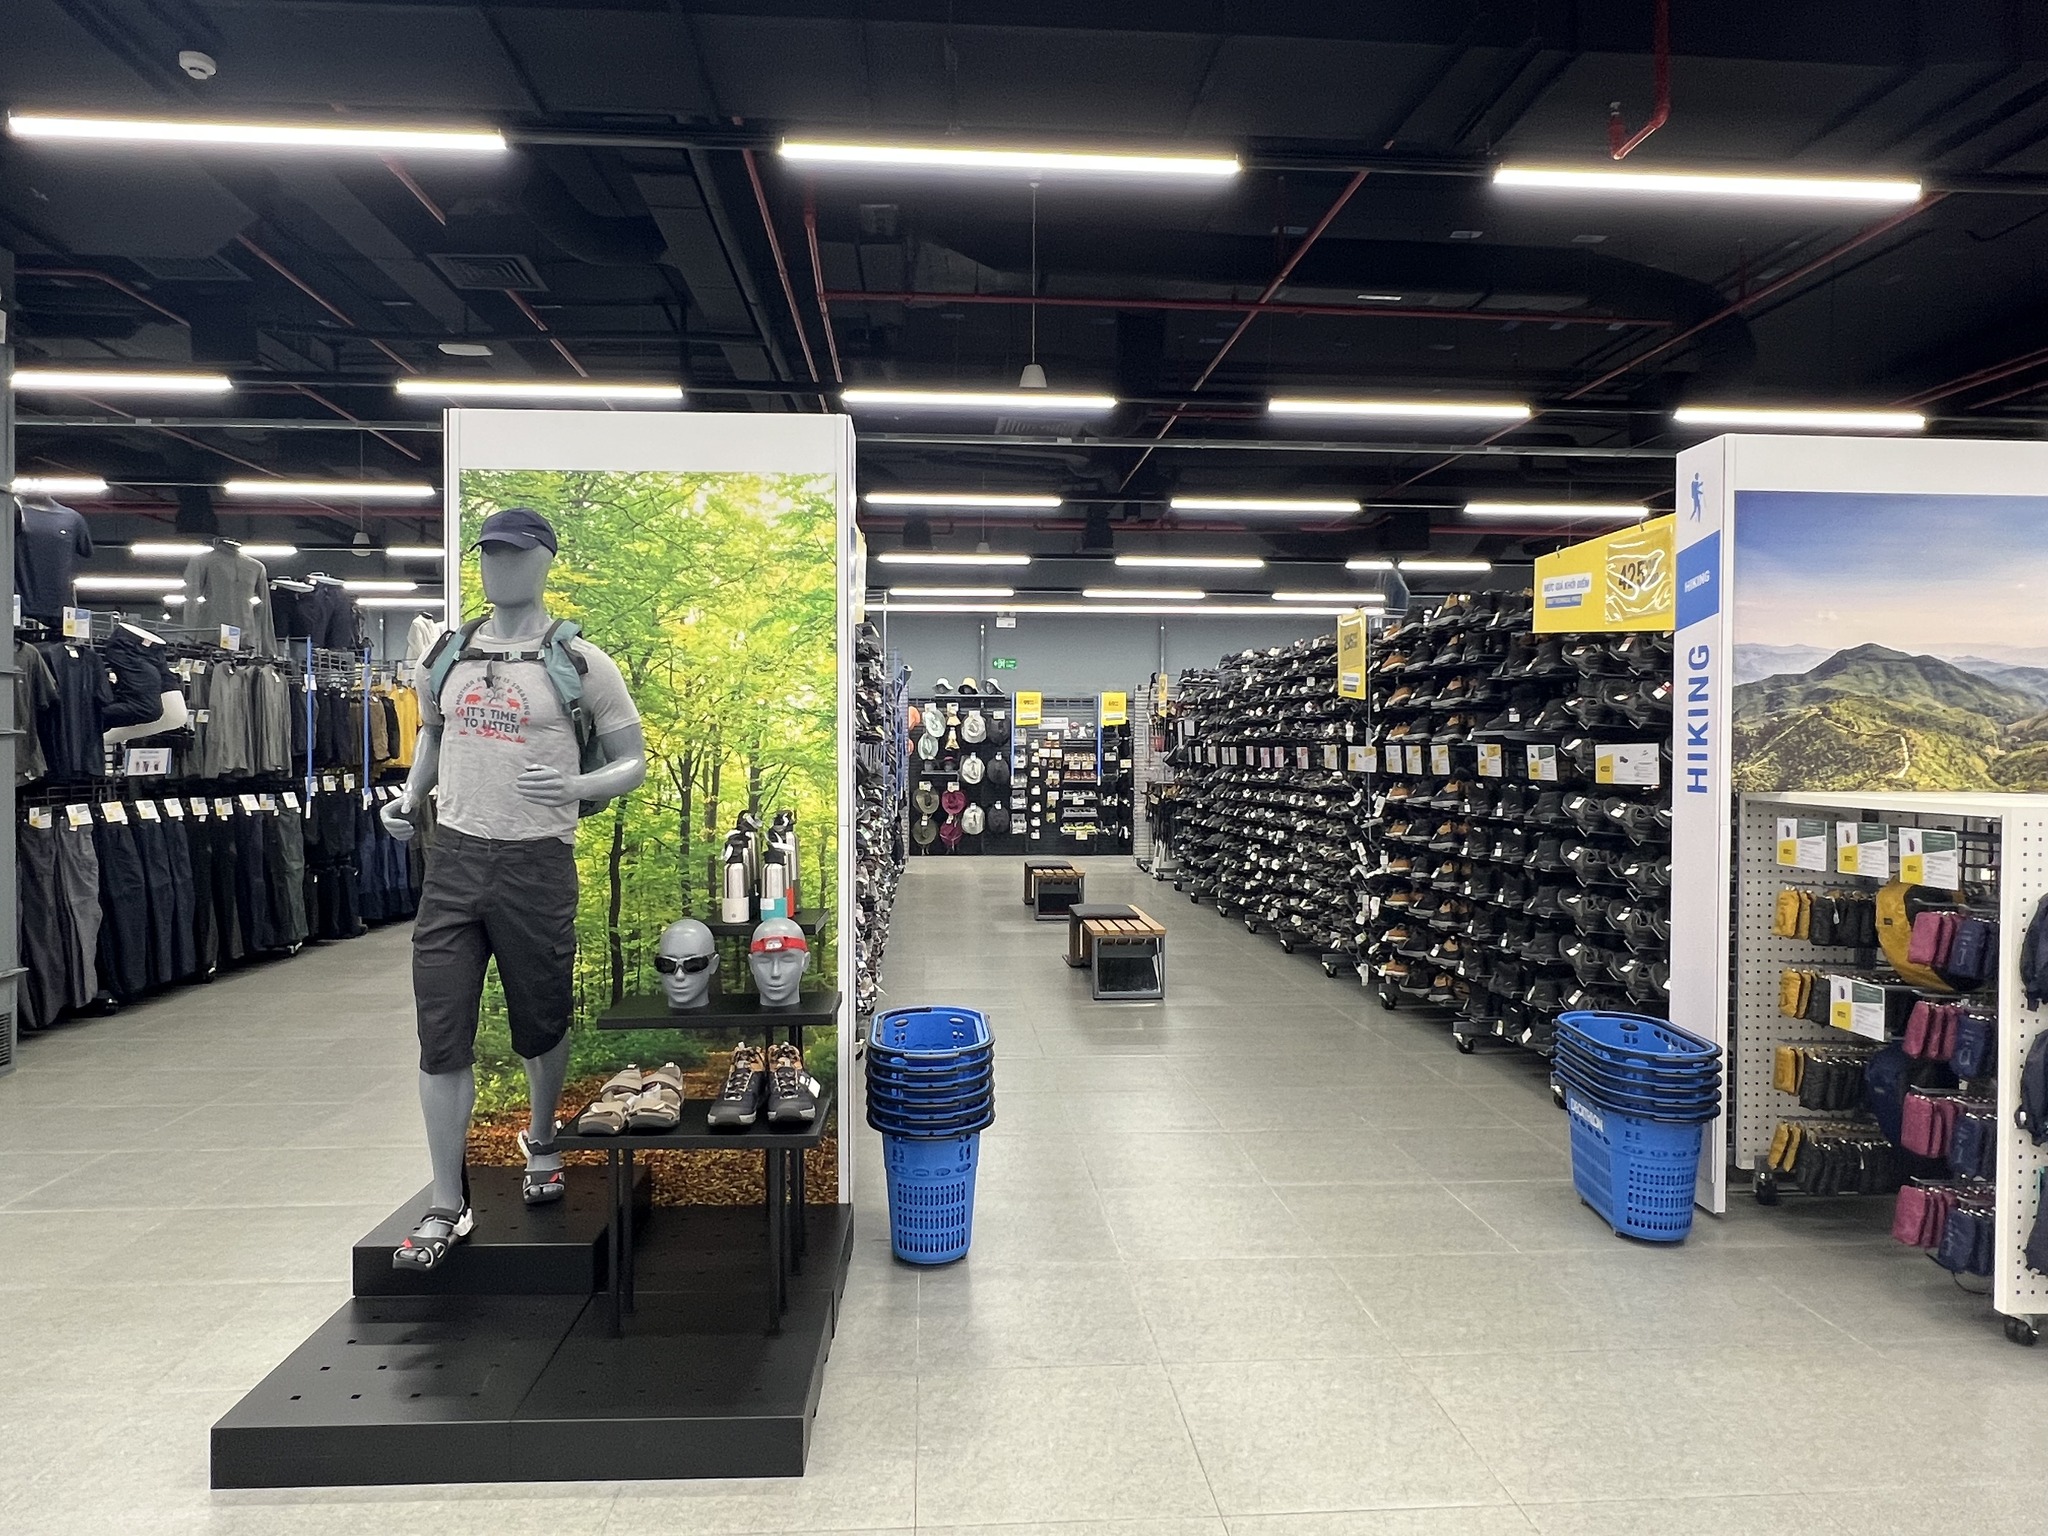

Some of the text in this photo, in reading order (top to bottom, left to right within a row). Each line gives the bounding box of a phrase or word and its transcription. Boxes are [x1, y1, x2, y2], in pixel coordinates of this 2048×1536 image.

[1684, 569, 1710, 593] HIKING
[456, 680, 475, 705] MOTHER
[511, 682, 531, 716] SPEAKING
[464, 717, 520, 734] TO LISTEN
[467, 706, 518, 723] IT'S TIME
[1686, 644, 1709, 794] HIKING
